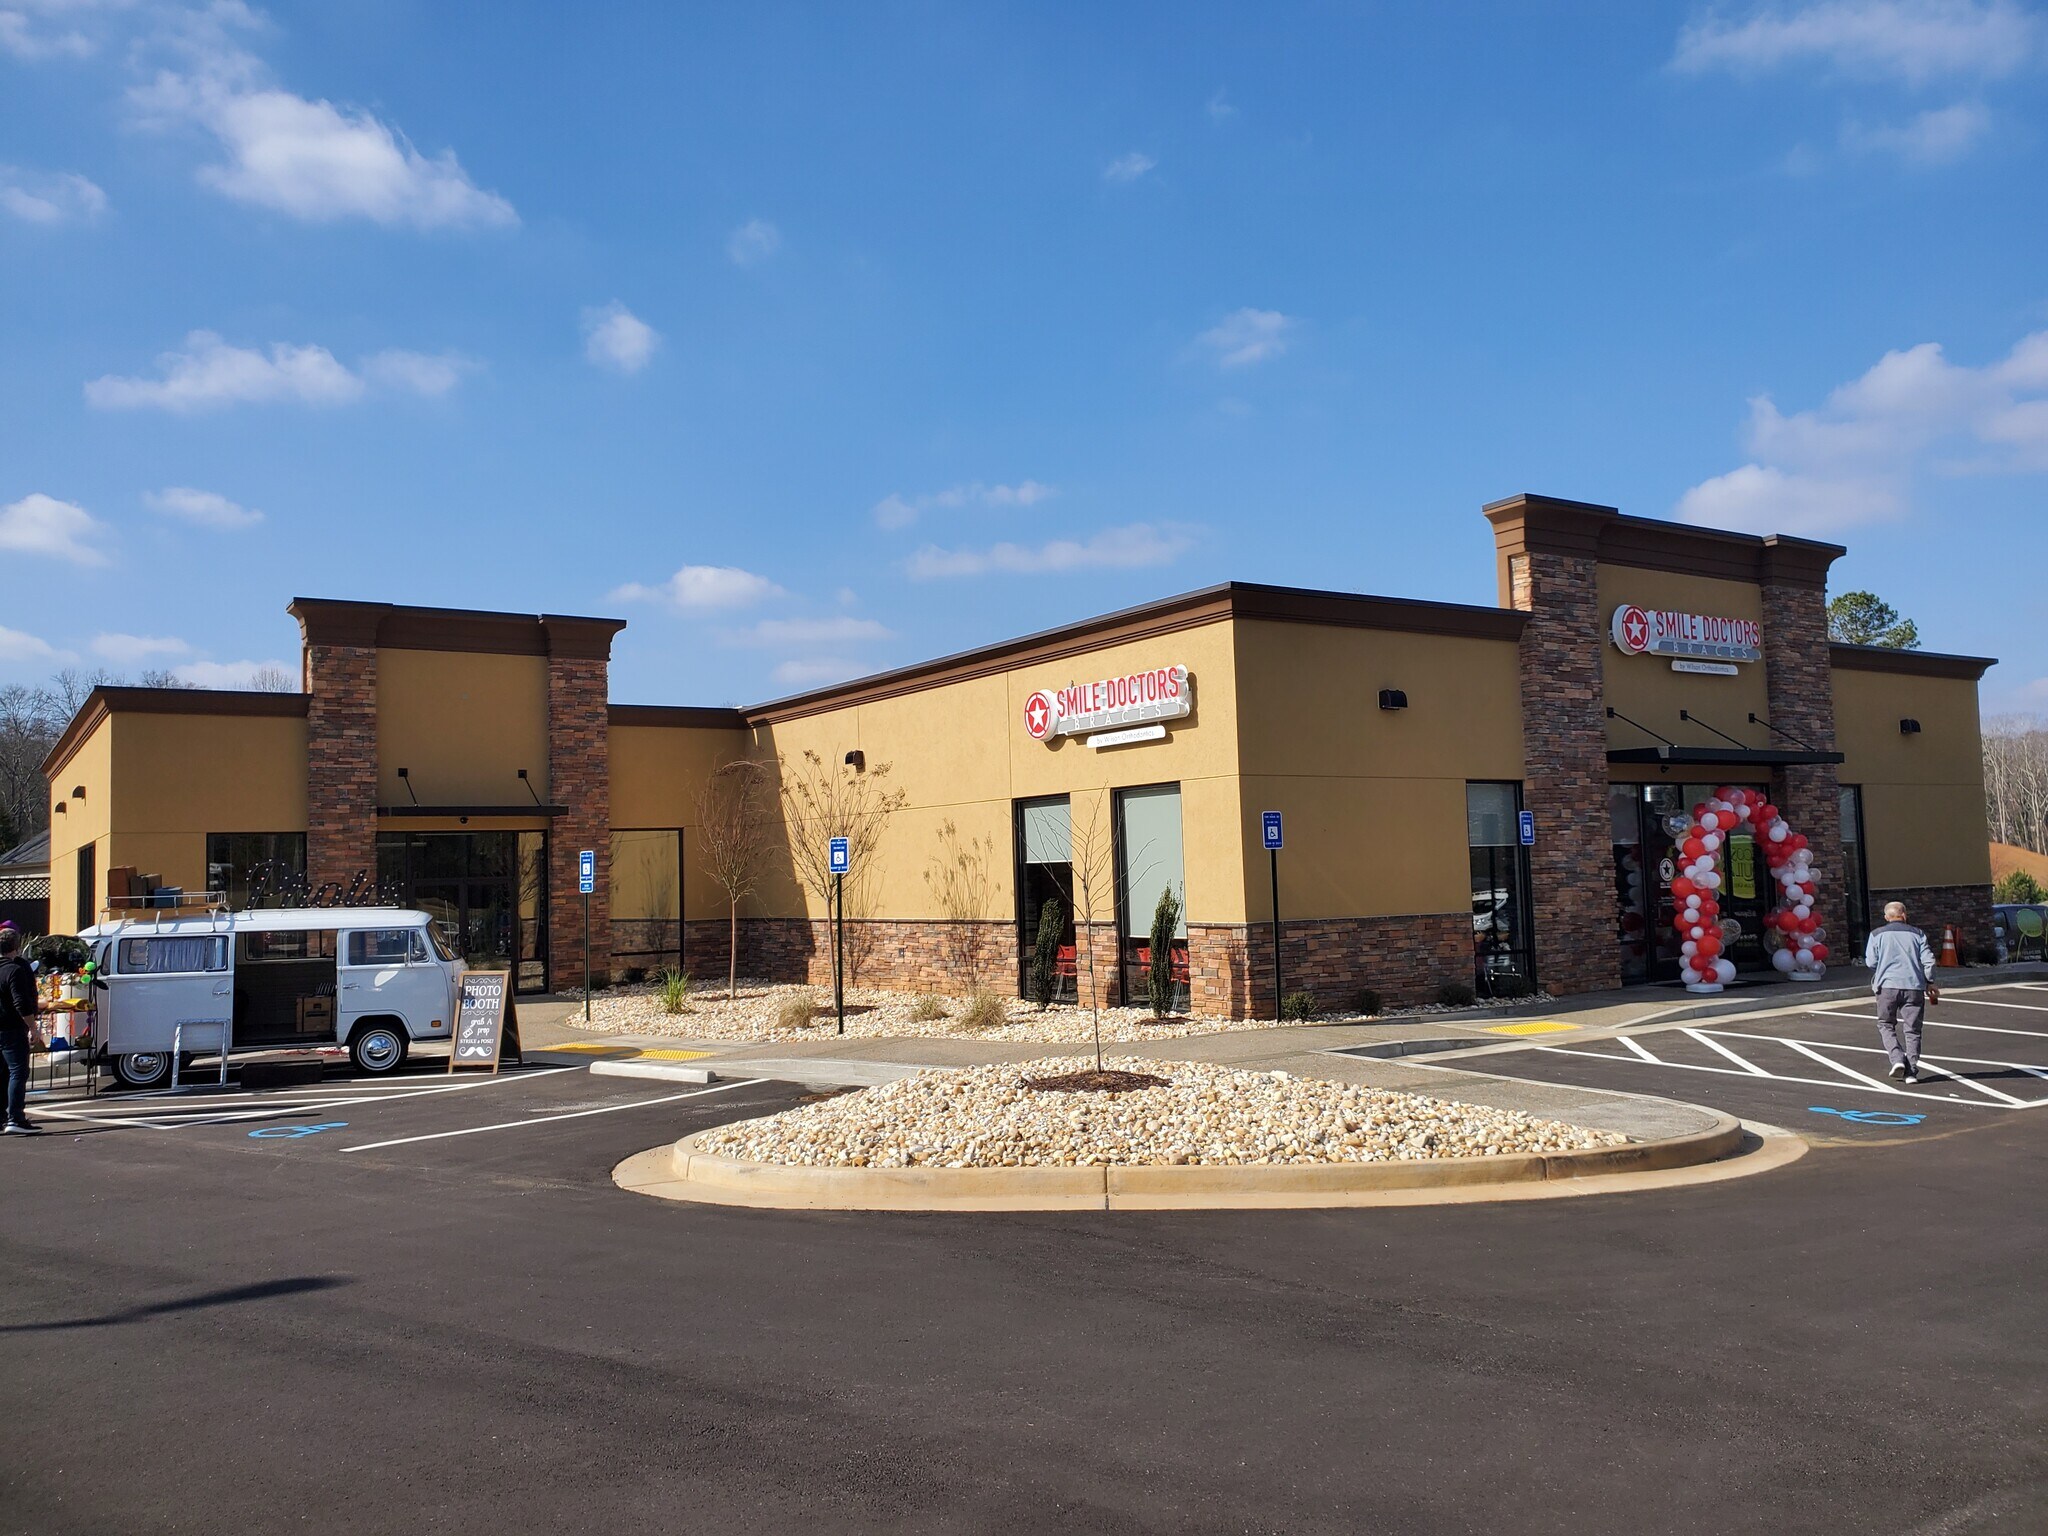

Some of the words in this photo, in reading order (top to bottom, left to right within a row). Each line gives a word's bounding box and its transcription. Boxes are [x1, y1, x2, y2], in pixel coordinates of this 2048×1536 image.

[1655, 610, 1697, 640] SMILE
[1702, 615, 1760, 646] DOCTORS
[1673, 641, 1747, 659] BRACES
[1057, 682, 1101, 717] SMILE
[1106, 667, 1179, 709] DOCTORS
[1074, 705, 1161, 730] BRACES
[464, 985, 501, 996] PHOTO
[462, 998, 500, 1009] BOOTH
[477, 1027, 490, 1036] prop
